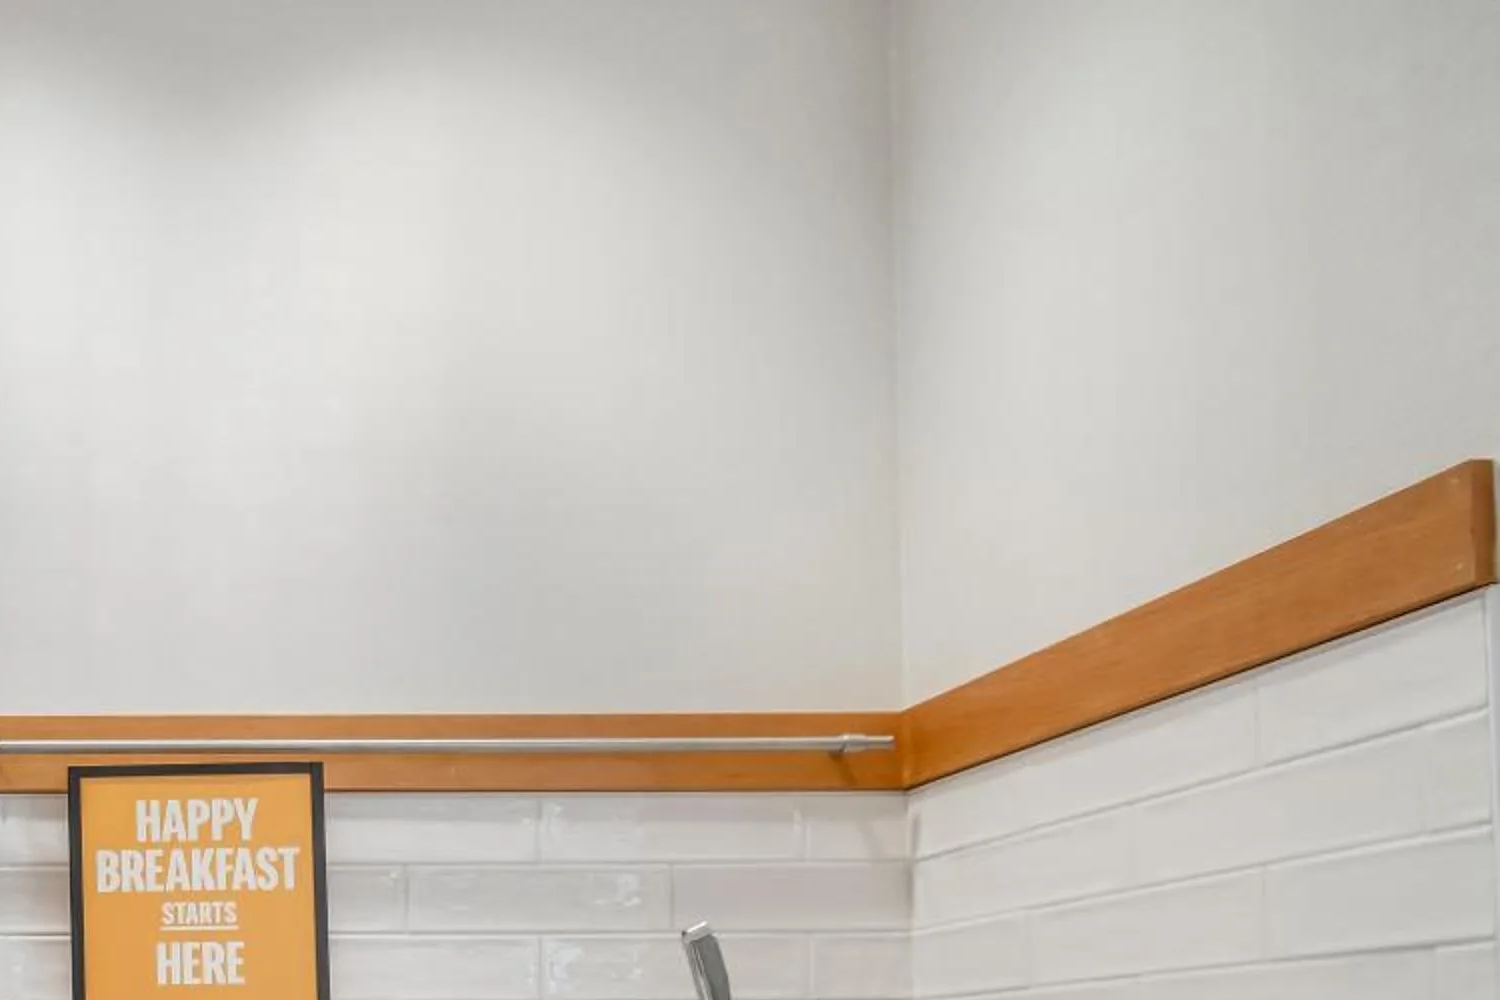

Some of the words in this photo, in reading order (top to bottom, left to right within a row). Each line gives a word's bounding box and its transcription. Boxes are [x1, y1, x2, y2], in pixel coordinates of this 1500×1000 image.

[135, 798, 258, 842] HAPPY
[95, 846, 299, 893] BREAKFAST
[161, 901, 237, 926] STARTS
[156, 941, 245, 985] HERE
